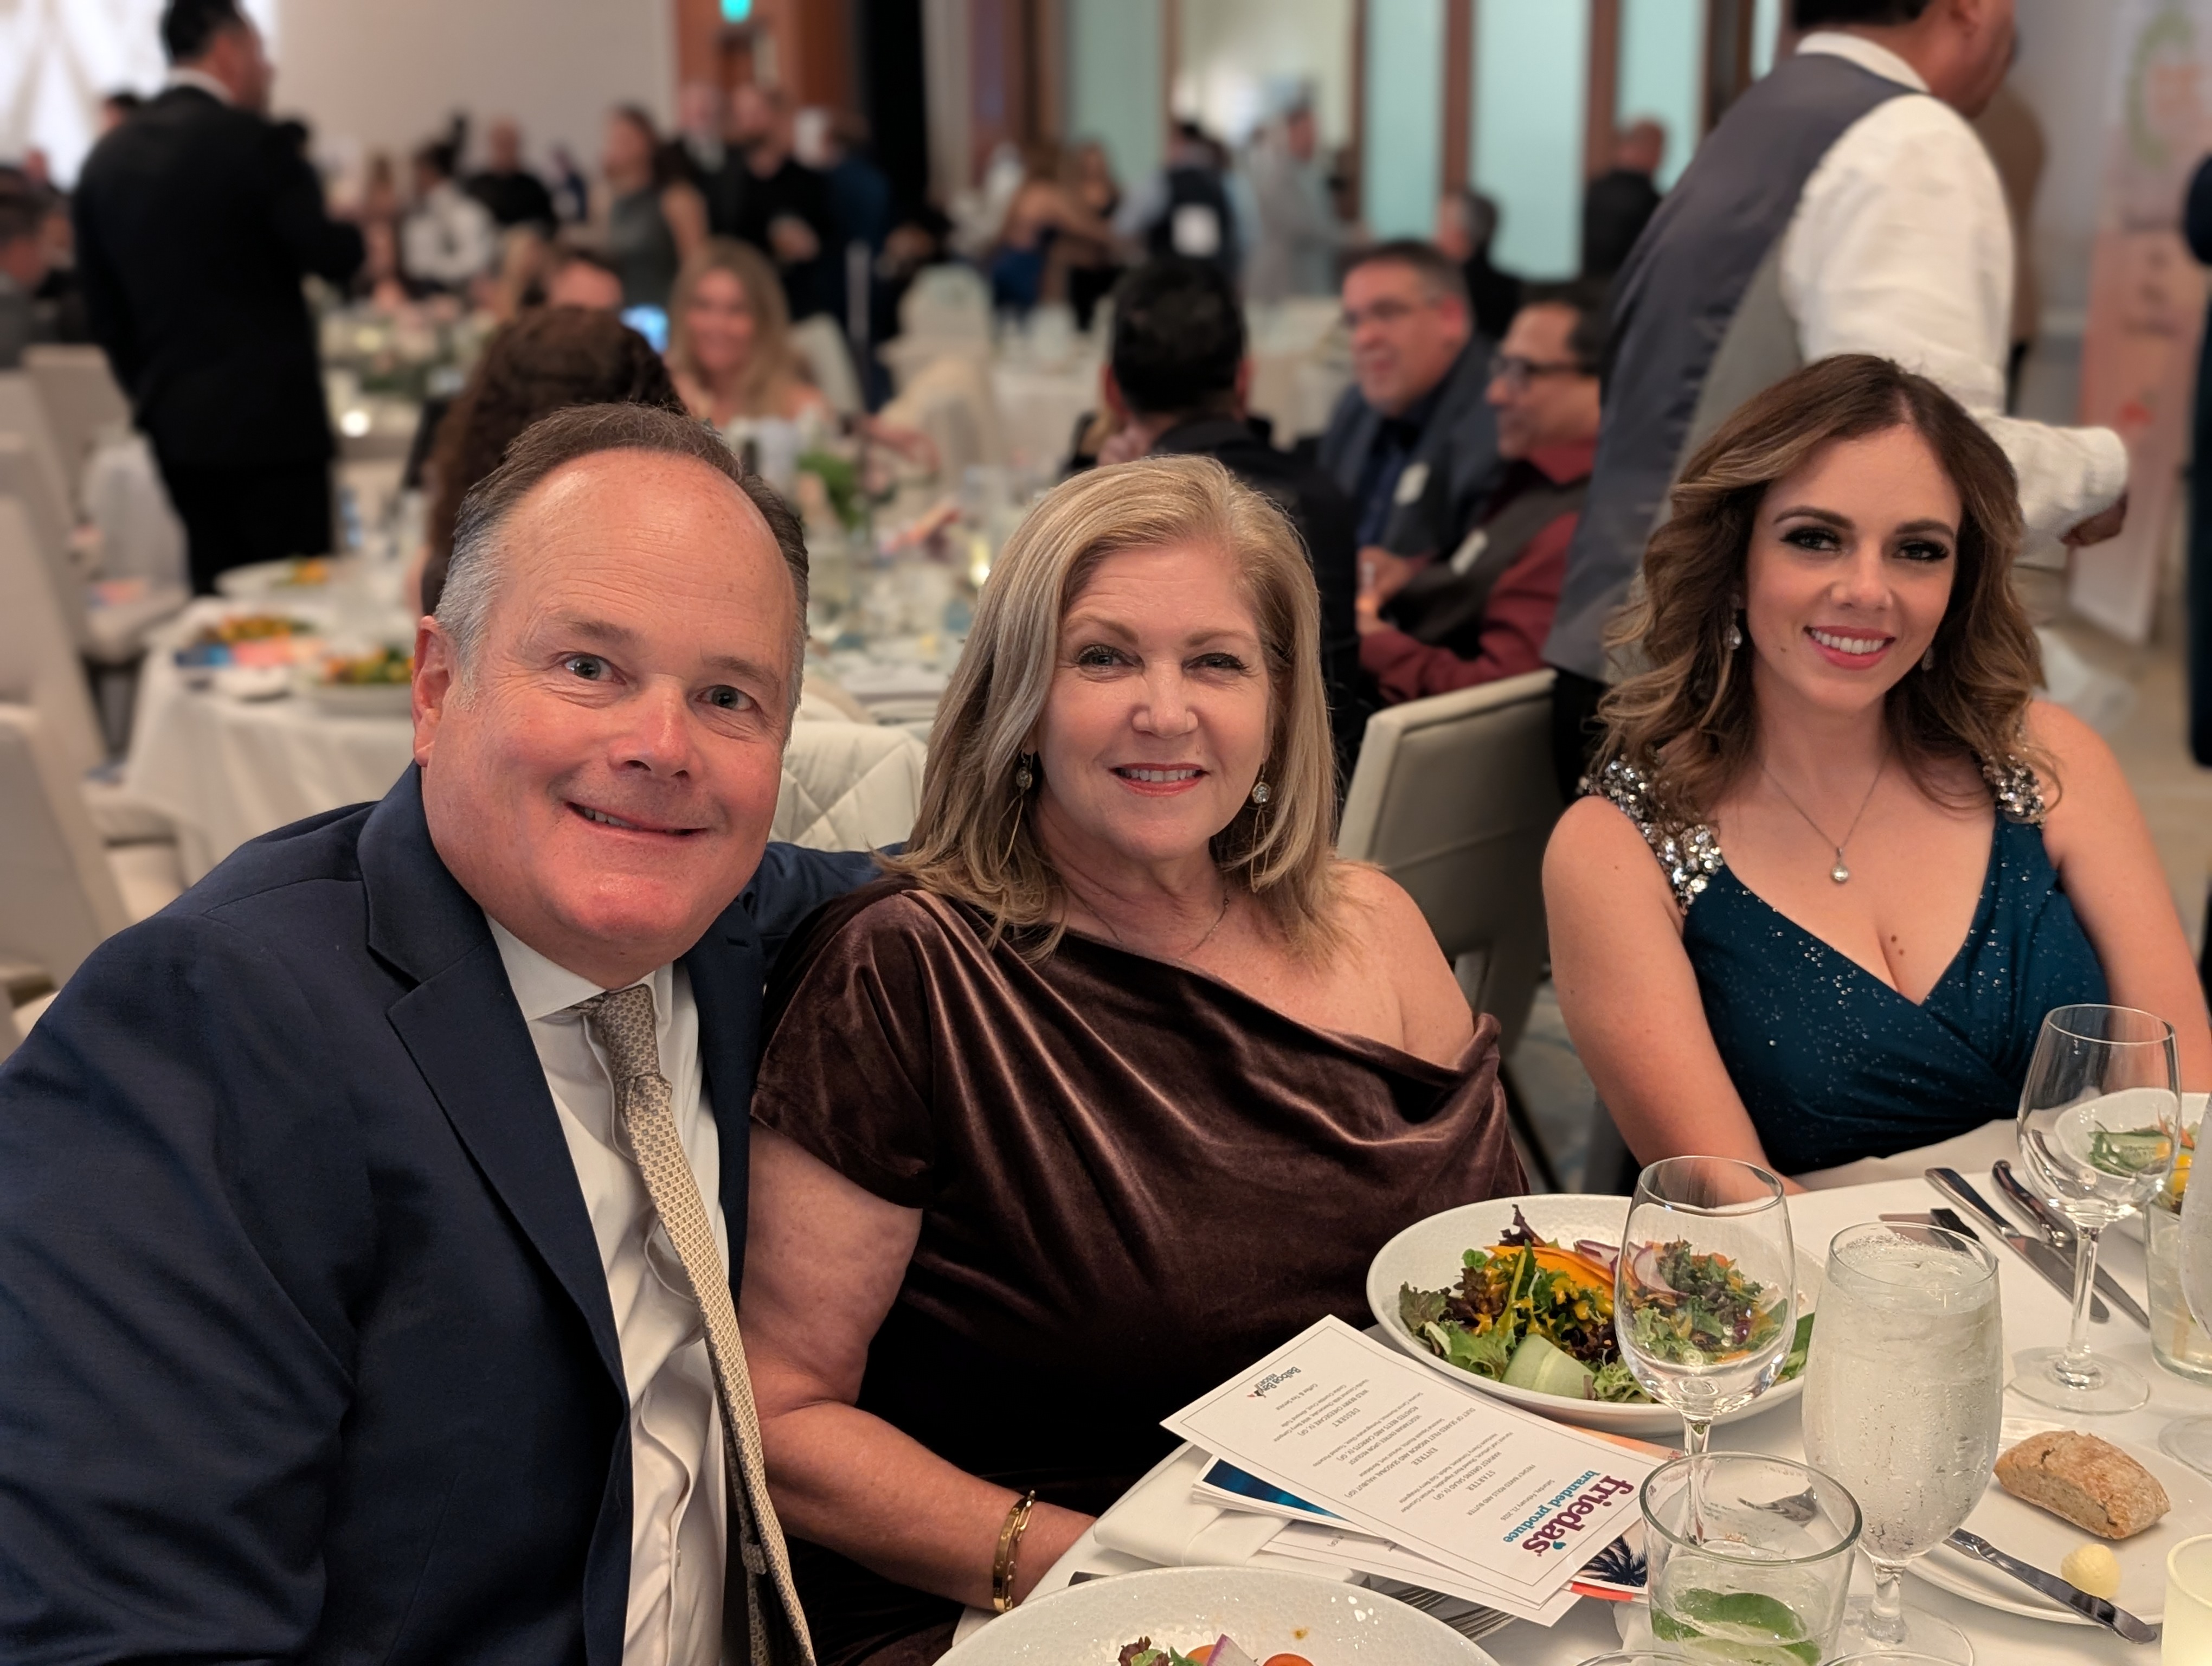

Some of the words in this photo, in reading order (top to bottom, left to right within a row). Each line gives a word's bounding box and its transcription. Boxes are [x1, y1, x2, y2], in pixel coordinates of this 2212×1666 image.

[1255, 1373, 1277, 1387] RESORT
[1271, 1366, 1302, 1385] Balboa
[1256, 1380, 1278, 1393] Bay
[1332, 1407, 1361, 1428] DESSERT
[1410, 1447, 1438, 1466] ENTREE
[1465, 1470, 1496, 1491] STARTER
[1547, 1470, 1602, 1508] branded
[1502, 1504, 1553, 1543] produce
[1522, 1475, 1635, 1555] frieda's
